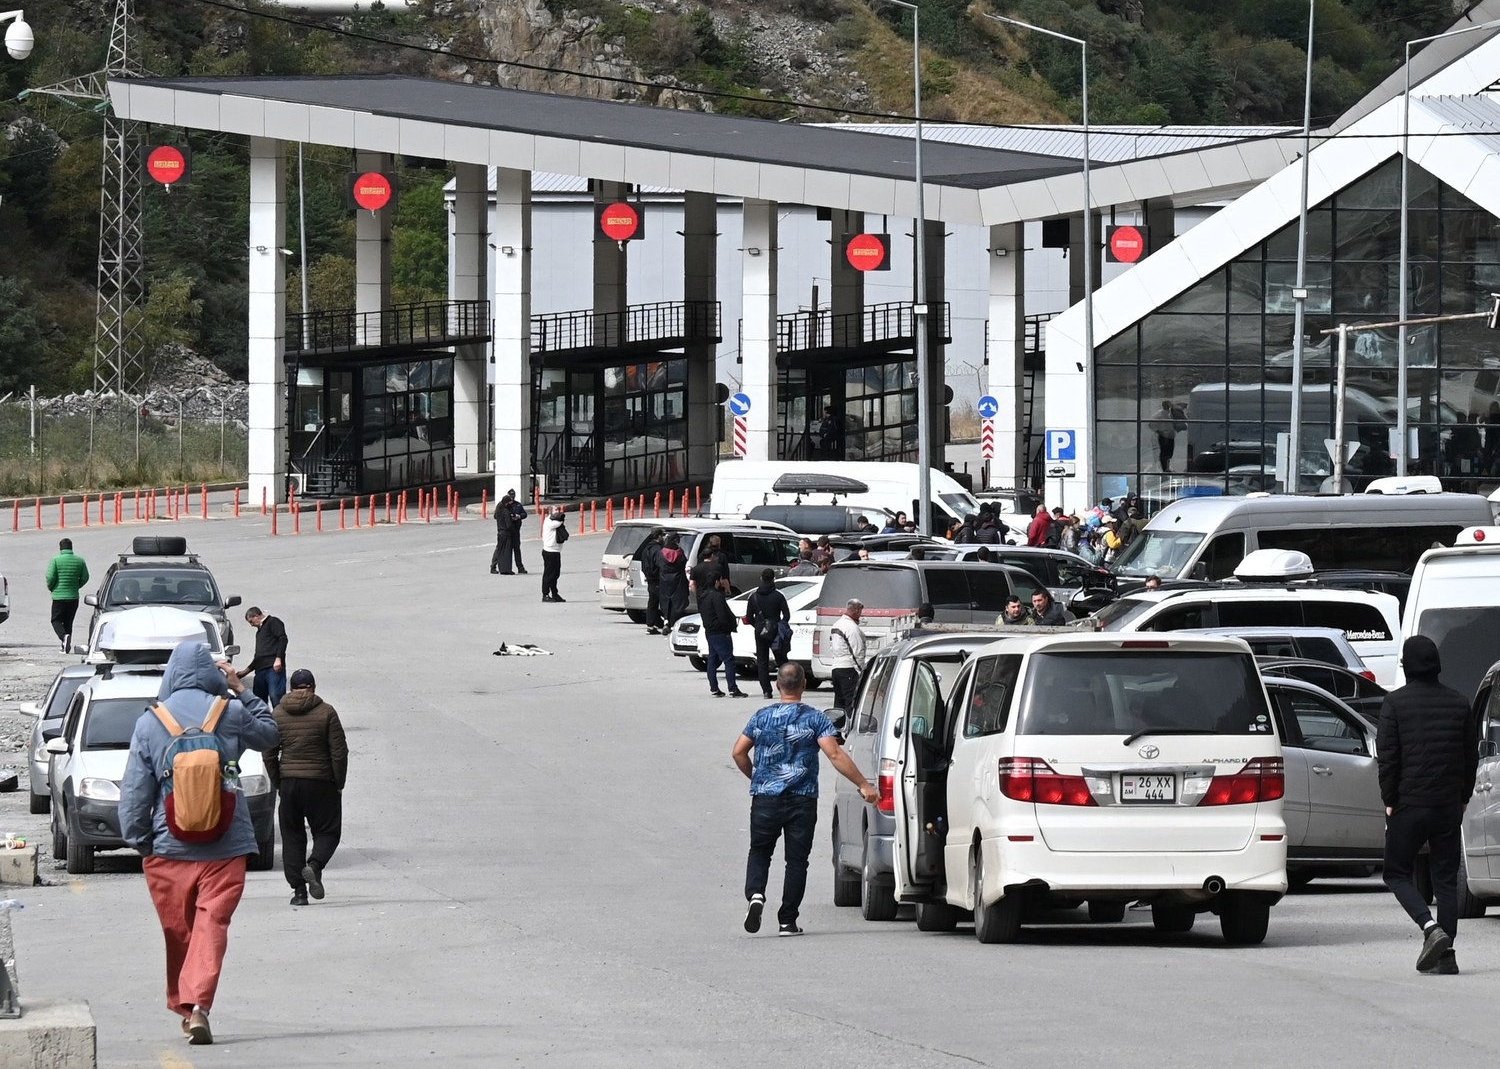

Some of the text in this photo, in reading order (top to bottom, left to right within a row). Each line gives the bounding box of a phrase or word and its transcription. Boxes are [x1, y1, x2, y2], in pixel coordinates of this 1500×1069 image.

[1051, 432, 1070, 458] P
[1139, 777, 1171, 788] 26 XX
[1145, 789, 1164, 800] 444
